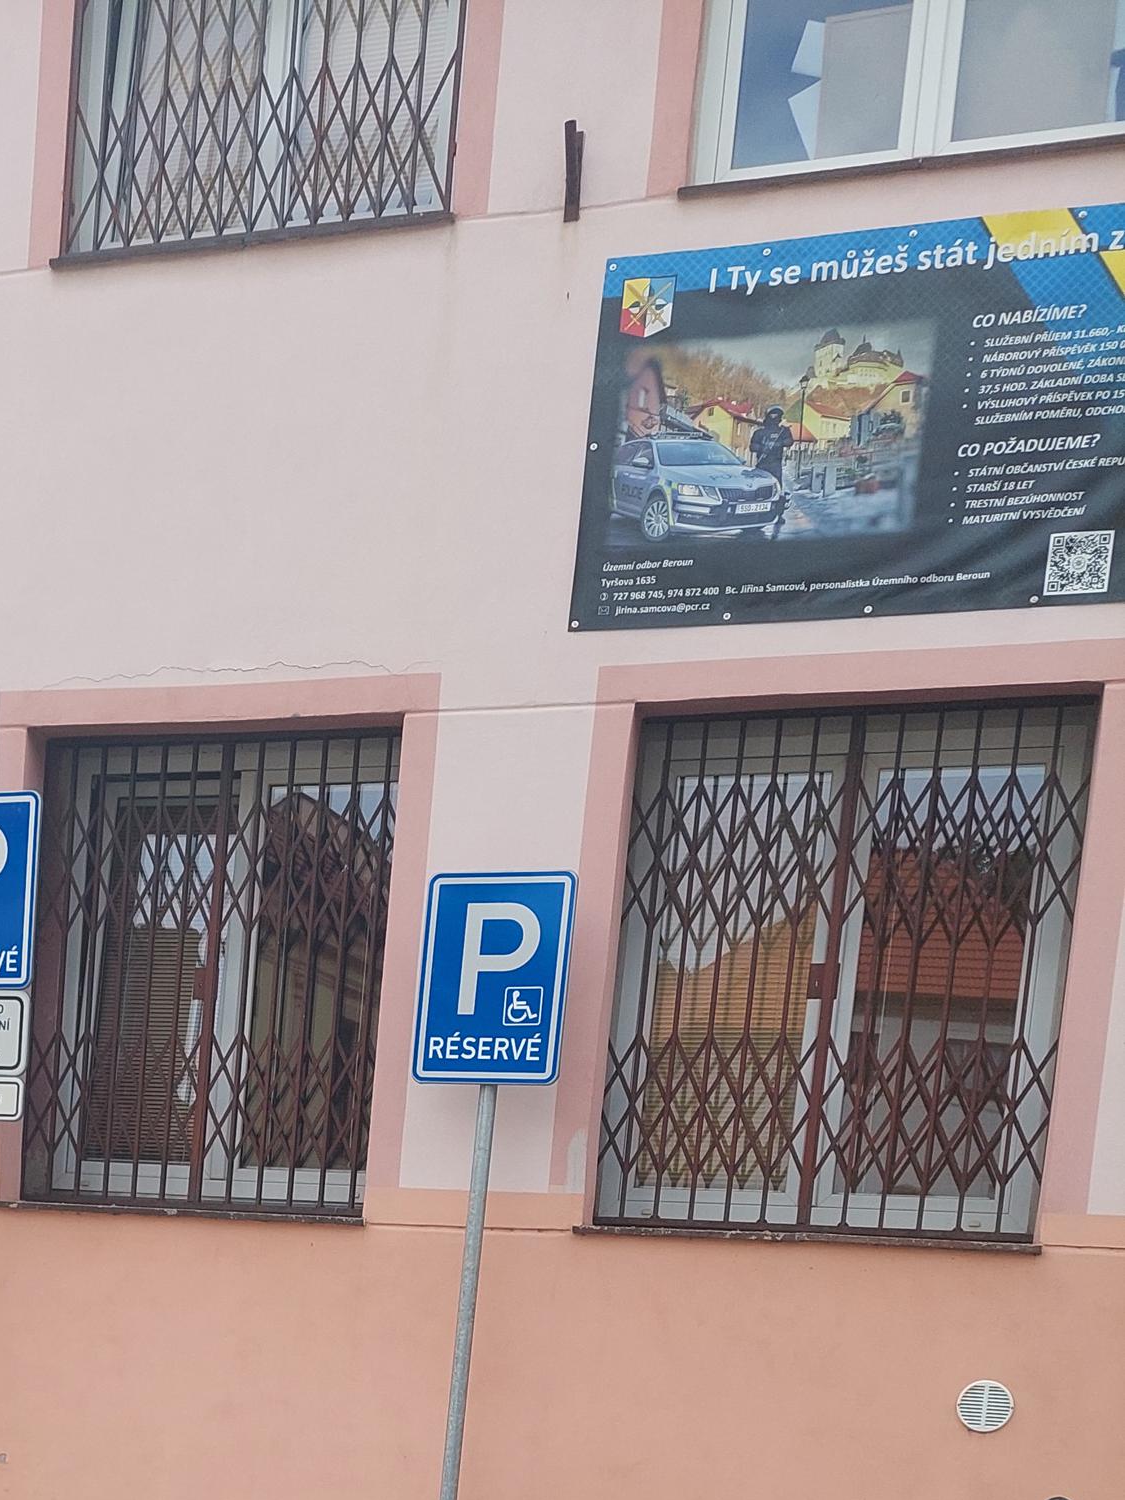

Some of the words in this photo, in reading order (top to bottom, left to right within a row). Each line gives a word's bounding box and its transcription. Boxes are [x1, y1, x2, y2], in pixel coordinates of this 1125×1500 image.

[708, 267, 718, 293] I
[727, 265, 762, 295] Ty
[769, 265, 801, 288] se
[810, 244, 909, 283] můžeš
[917, 236, 977, 272] stát
[983, 228, 1099, 270] jedním
[1108, 230, 1125, 250] z
[972, 314, 996, 328] CO
[997, 304, 1088, 326] NABÍZÍME?
[984, 332, 1033, 347] SLUŽEBNÍ
[1034, 329, 1073, 343] PŘÍJEM
[982, 349, 1043, 363] NÁBOROVÝ
[1098, 340, 1119, 351] 150
[980, 369, 988, 379] 6
[989, 364, 1026, 378] TÝDNŮ
[1026, 359, 1085, 375] DOVOLENÉ,
[978, 385, 1000, 395] 37,5
[1002, 381, 1028, 392] HOD.
[1029, 372, 1084, 390] ZÁKLADNÍ
[1083, 373, 1115, 385] DOBA
[977, 394, 1040, 410] VÝSLUHOVÝ
[1038, 389, 1094, 405] PŘÍSPĚVEK
[1095, 389, 1111, 401] PO
[1111, 389, 1125, 399] 15
[974, 410, 1034, 426] SLUŽEBNÍM
[1034, 406, 1083, 420] POMĚRU,
[957, 443, 981, 458] CO
[983, 433, 1102, 456] POŽADUJEME?
[967, 463, 1005, 478] STÁTNÍ
[1006, 459, 1065, 475] OBČANSTVÍ
[1065, 456, 1098, 470] ČESKÉ
[966, 481, 1001, 493] STARŠÍ
[1003, 481, 1015, 490] 18
[1016, 480, 1036, 489] LET
[964, 495, 1006, 509] TRESTNÍ
[1006, 491, 1086, 506] BEZÚHONNOST
[961, 510, 1022, 525] MATURITNÍ
[1022, 505, 1087, 520] VYSVĚDČENÍ
[602, 561, 635, 572] Územní
[635, 559, 661, 570] odbor
[662, 558, 694, 568] Beroun
[601, 577, 634, 588] Tyršova
[635, 576, 657, 585] 1635
[725, 585, 738, 595] Bc.
[740, 583, 764, 594] Jiřina
[765, 579, 809, 592] Samcová,
[809, 578, 870, 593] personalistka
[871, 574, 918, 587] Územního
[919, 572, 954, 583] odboru
[955, 570, 991, 582] Beroun
[613, 592, 629, 601] 727
[629, 590, 646, 600] 968
[647, 590, 666, 600] 745,
[667, 588, 684, 598] 974
[685, 587, 701, 597] 872
[702, 586, 720, 596] 400
[614, 602, 711, 616] jirina.samcova@pcr.cz
[457, 902, 541, 1015] P
[428, 1031, 542, 1061] RÉSERVÉ
